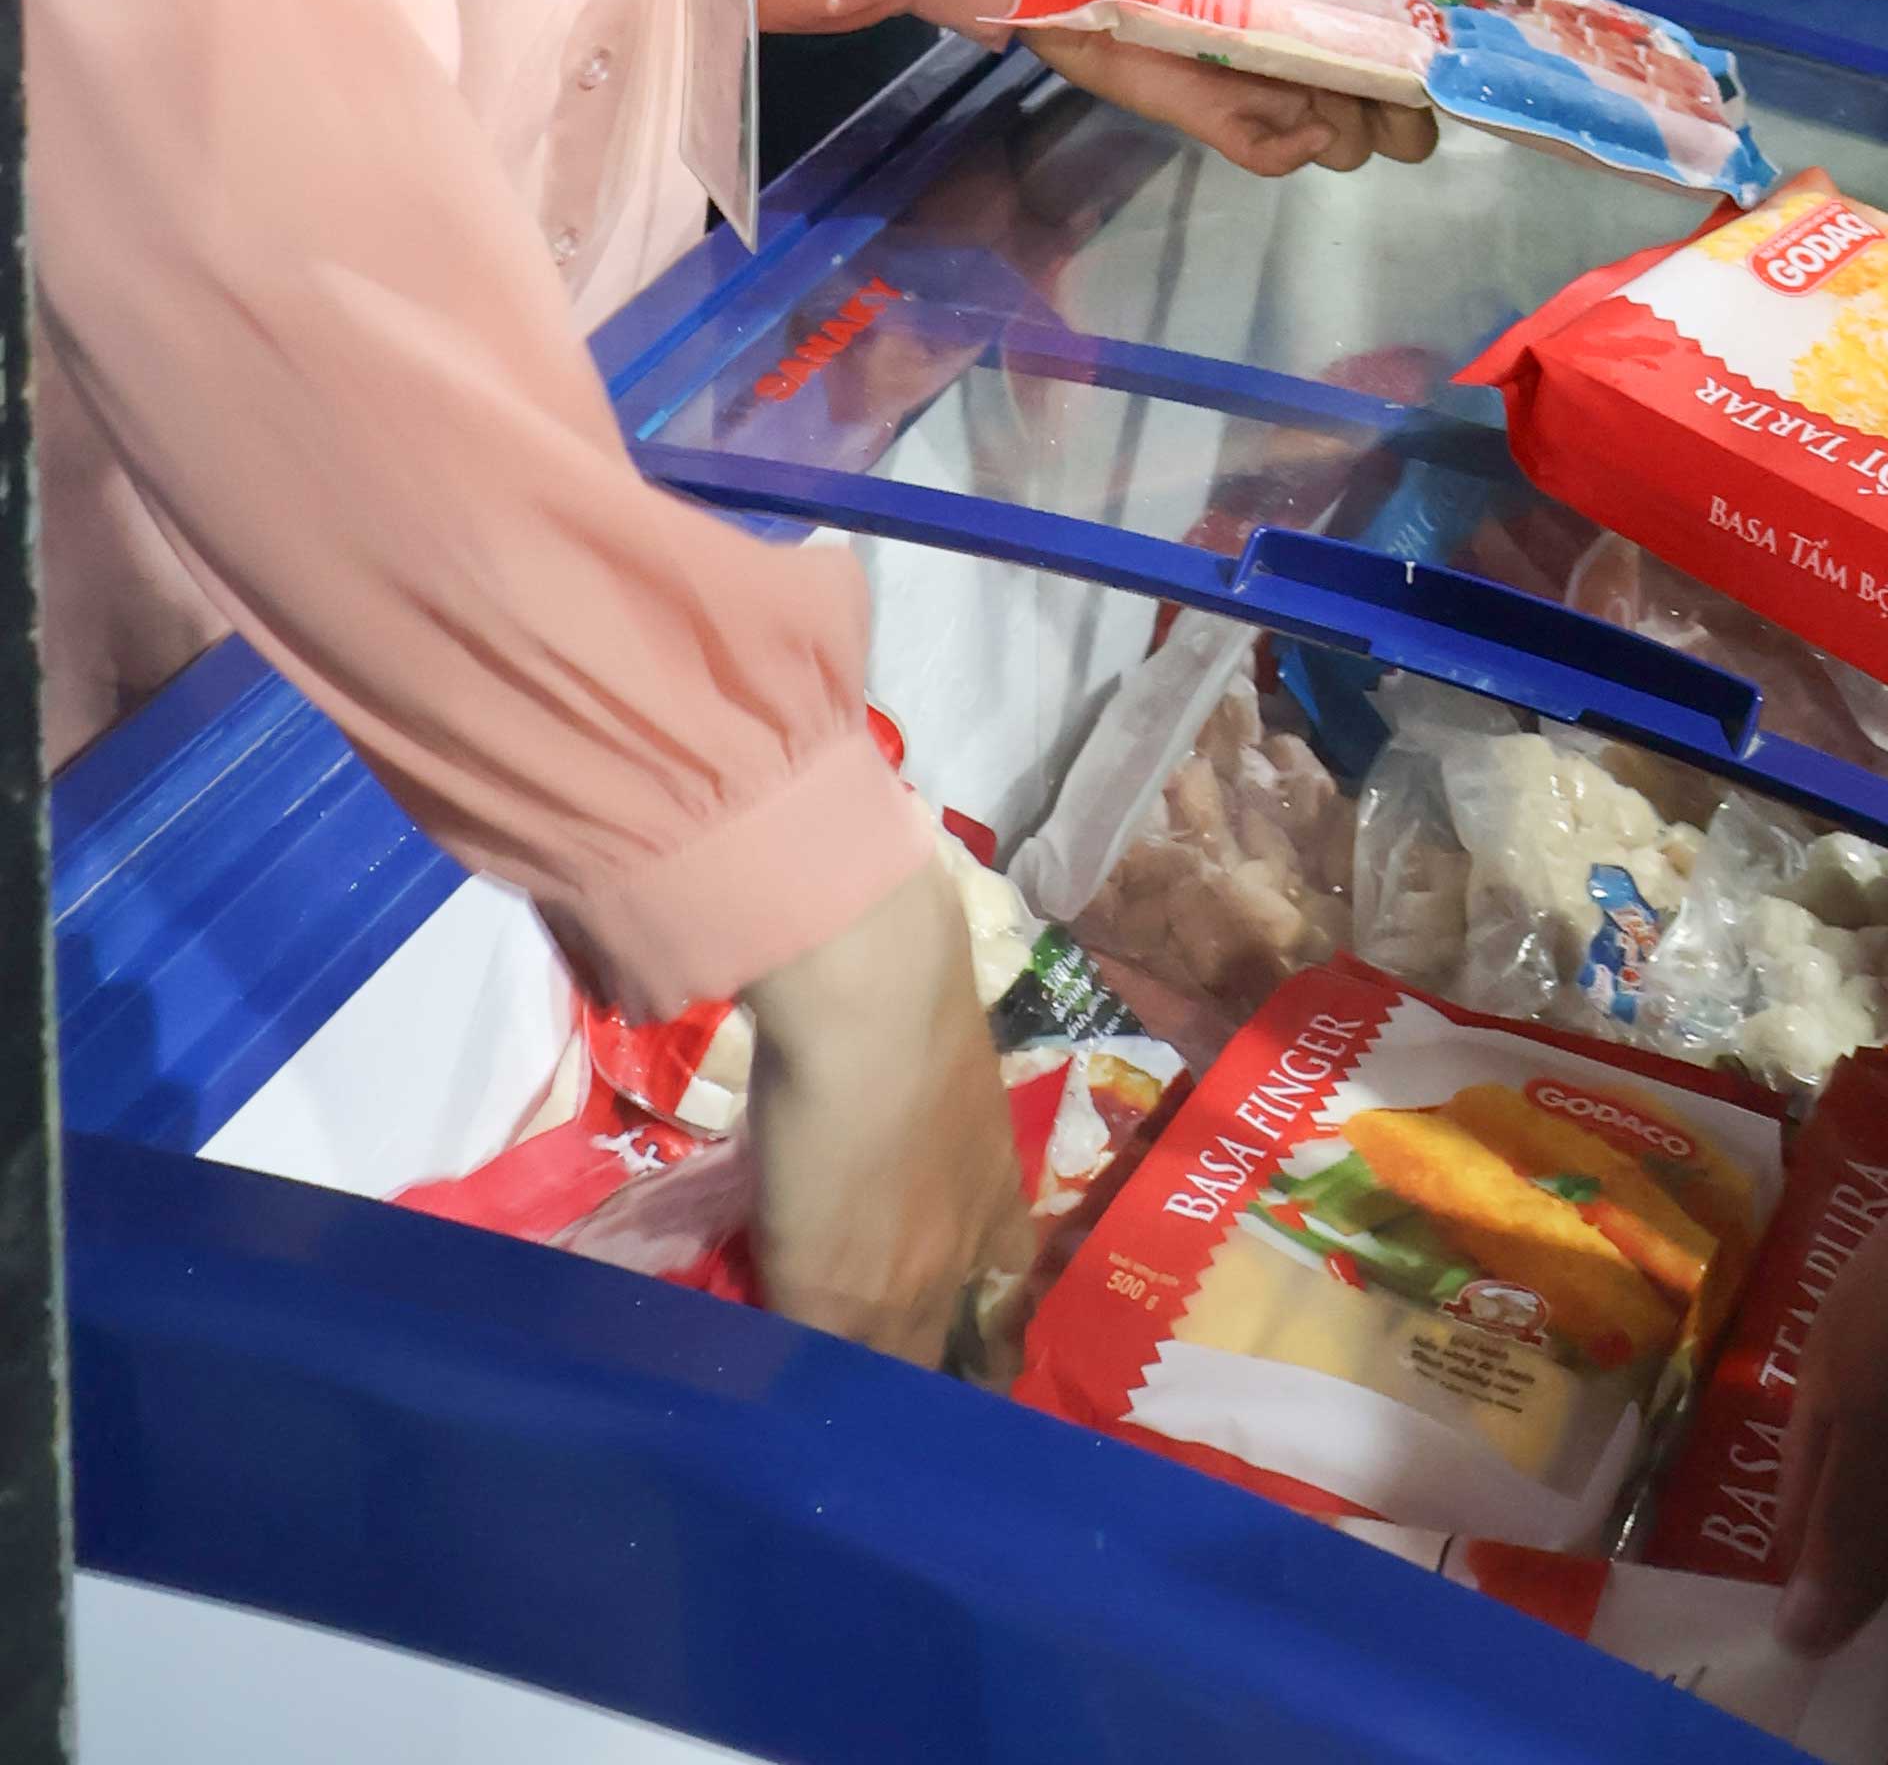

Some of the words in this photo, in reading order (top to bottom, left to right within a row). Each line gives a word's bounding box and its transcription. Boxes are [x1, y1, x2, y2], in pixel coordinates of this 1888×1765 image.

[1695, 377, 1848, 462] TARTAR
[1707, 495, 1778, 555] BASA
[1163, 1134, 1267, 1222] BASA
[1235, 1014, 1364, 1140] FINGER
[1536, 1087, 1690, 1156] GODACO
[1106, 1269, 1146, 1301] 500
